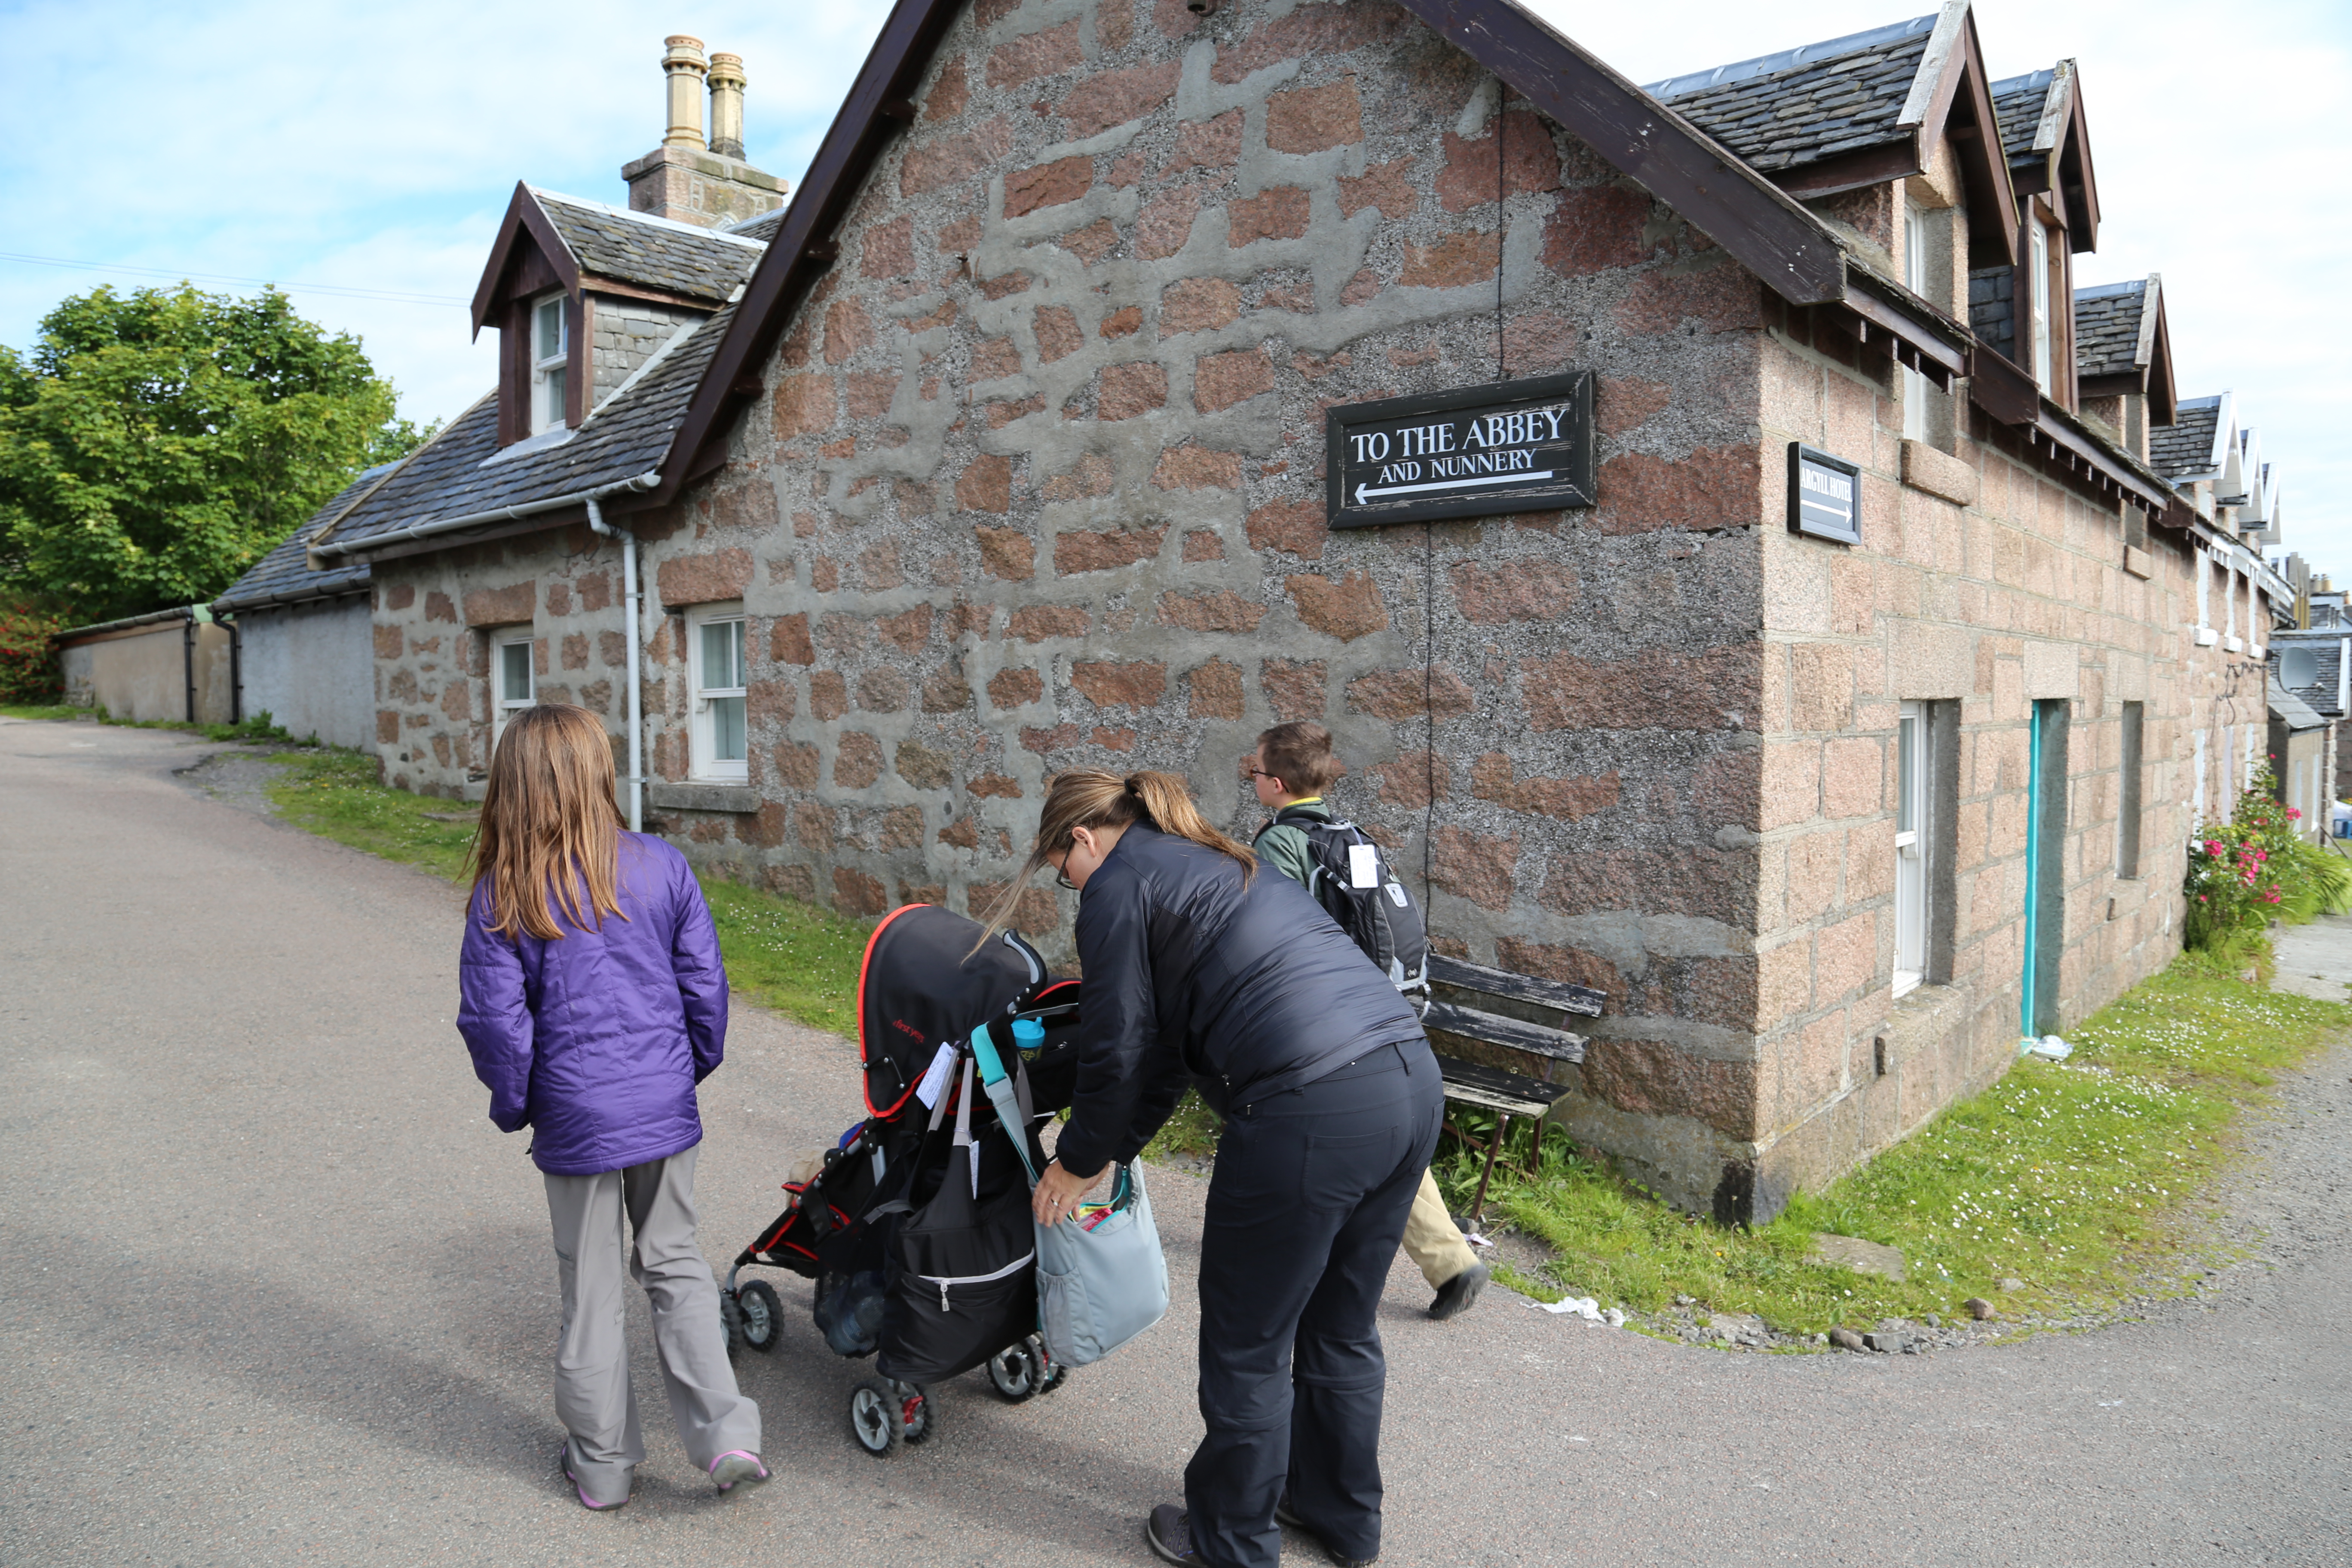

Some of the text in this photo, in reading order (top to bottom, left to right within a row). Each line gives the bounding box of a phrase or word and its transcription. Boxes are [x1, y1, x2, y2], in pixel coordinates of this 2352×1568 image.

[1351, 408, 1568, 463] TO THE ABBEY
[1378, 448, 1537, 484] AND NUNNERY
[1801, 467, 1853, 502] ARGYLL HOTEL
